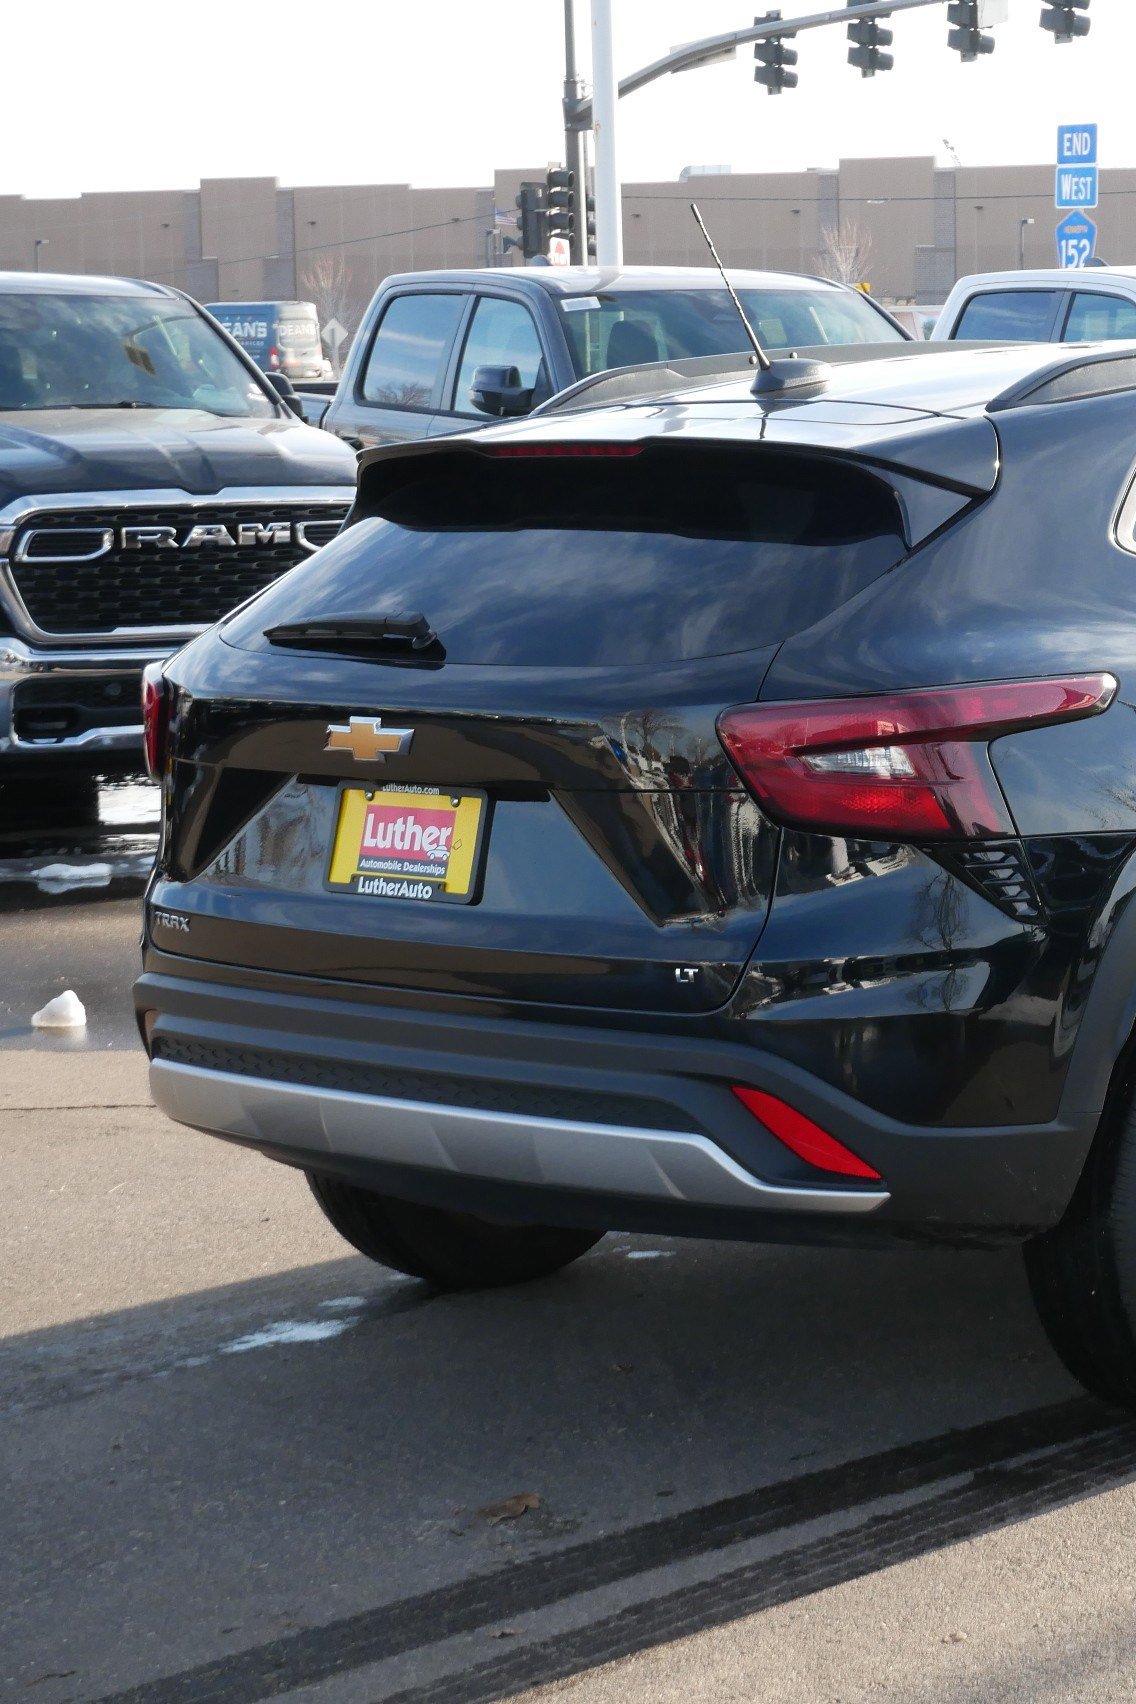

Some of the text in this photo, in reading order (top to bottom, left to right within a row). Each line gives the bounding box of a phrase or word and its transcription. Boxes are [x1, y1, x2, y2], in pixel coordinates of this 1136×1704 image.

[1063, 132, 1091, 156] END
[1061, 239, 1090, 269] 152
[221, 322, 268, 339] EAN'S
[121, 522, 291, 549] RAM
[363, 813, 453, 851] Luther
[360, 858, 446, 876] Automobile Dealerships
[357, 876, 433, 899] LutherAuto
[155, 911, 190, 932] TRAX
[675, 968, 699, 983] LT
